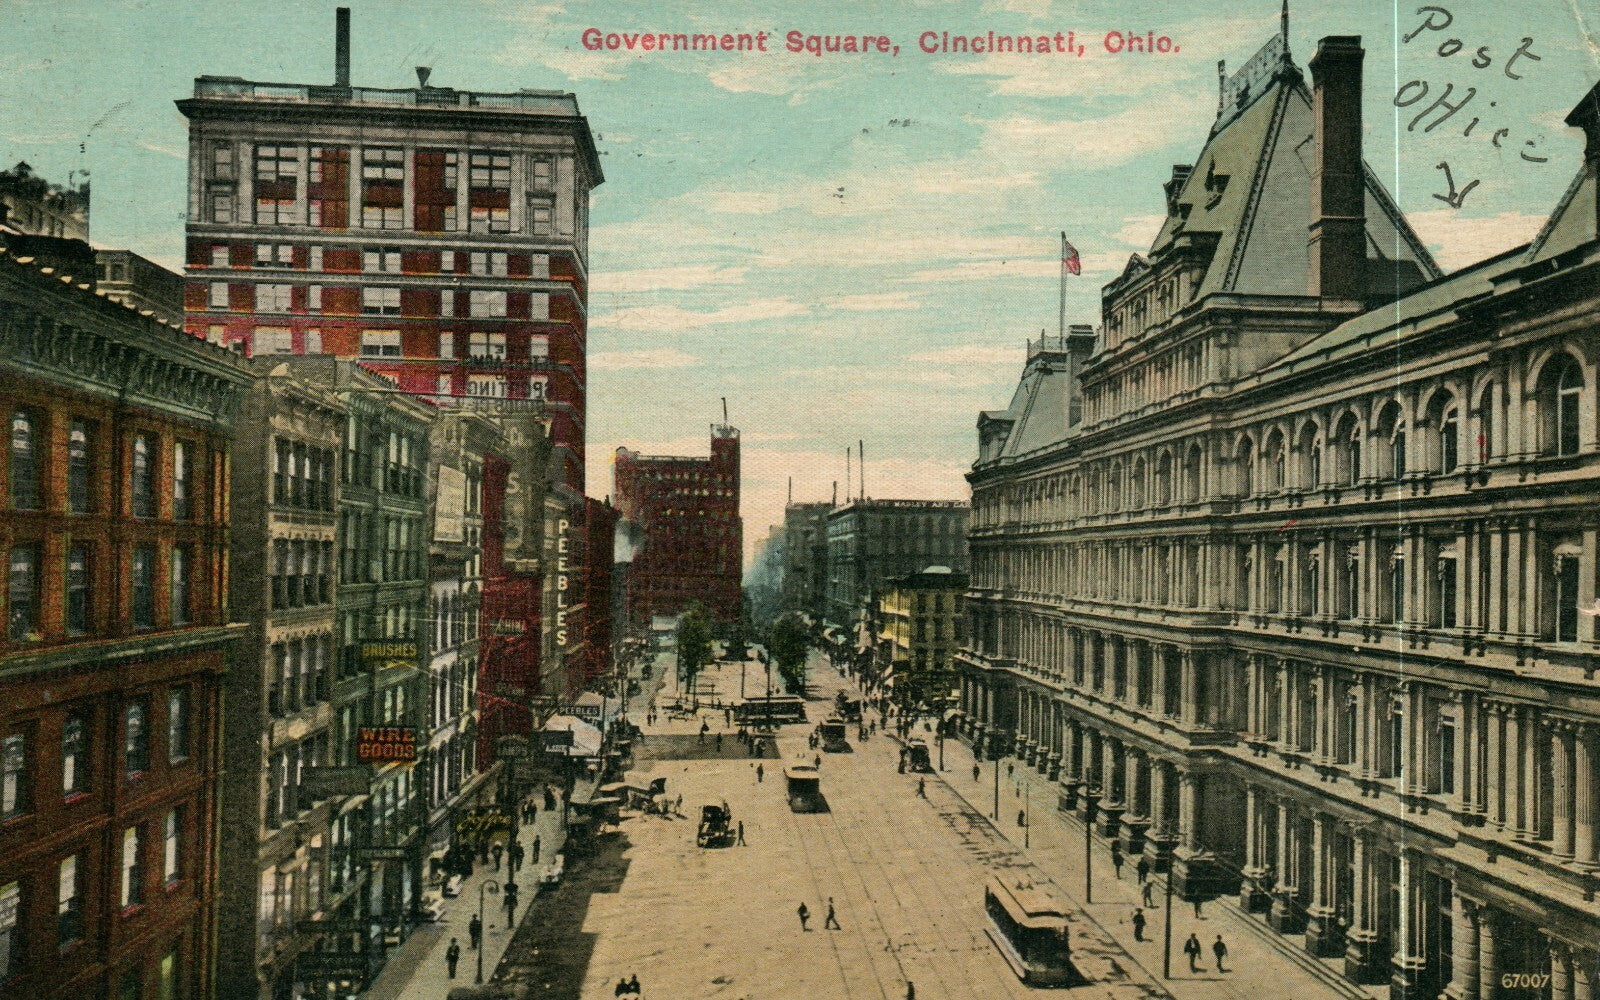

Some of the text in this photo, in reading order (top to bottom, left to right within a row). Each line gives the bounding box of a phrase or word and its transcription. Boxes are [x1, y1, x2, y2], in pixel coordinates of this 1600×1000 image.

[1402, 5, 1541, 81] Post
[556, 518, 569, 646] PEEBLES
[362, 642, 417, 657] BRUSHES
[559, 706, 598, 715] PEEBLES
[360, 727, 416, 742] WIRE
[359, 743, 415, 758] GOODS
